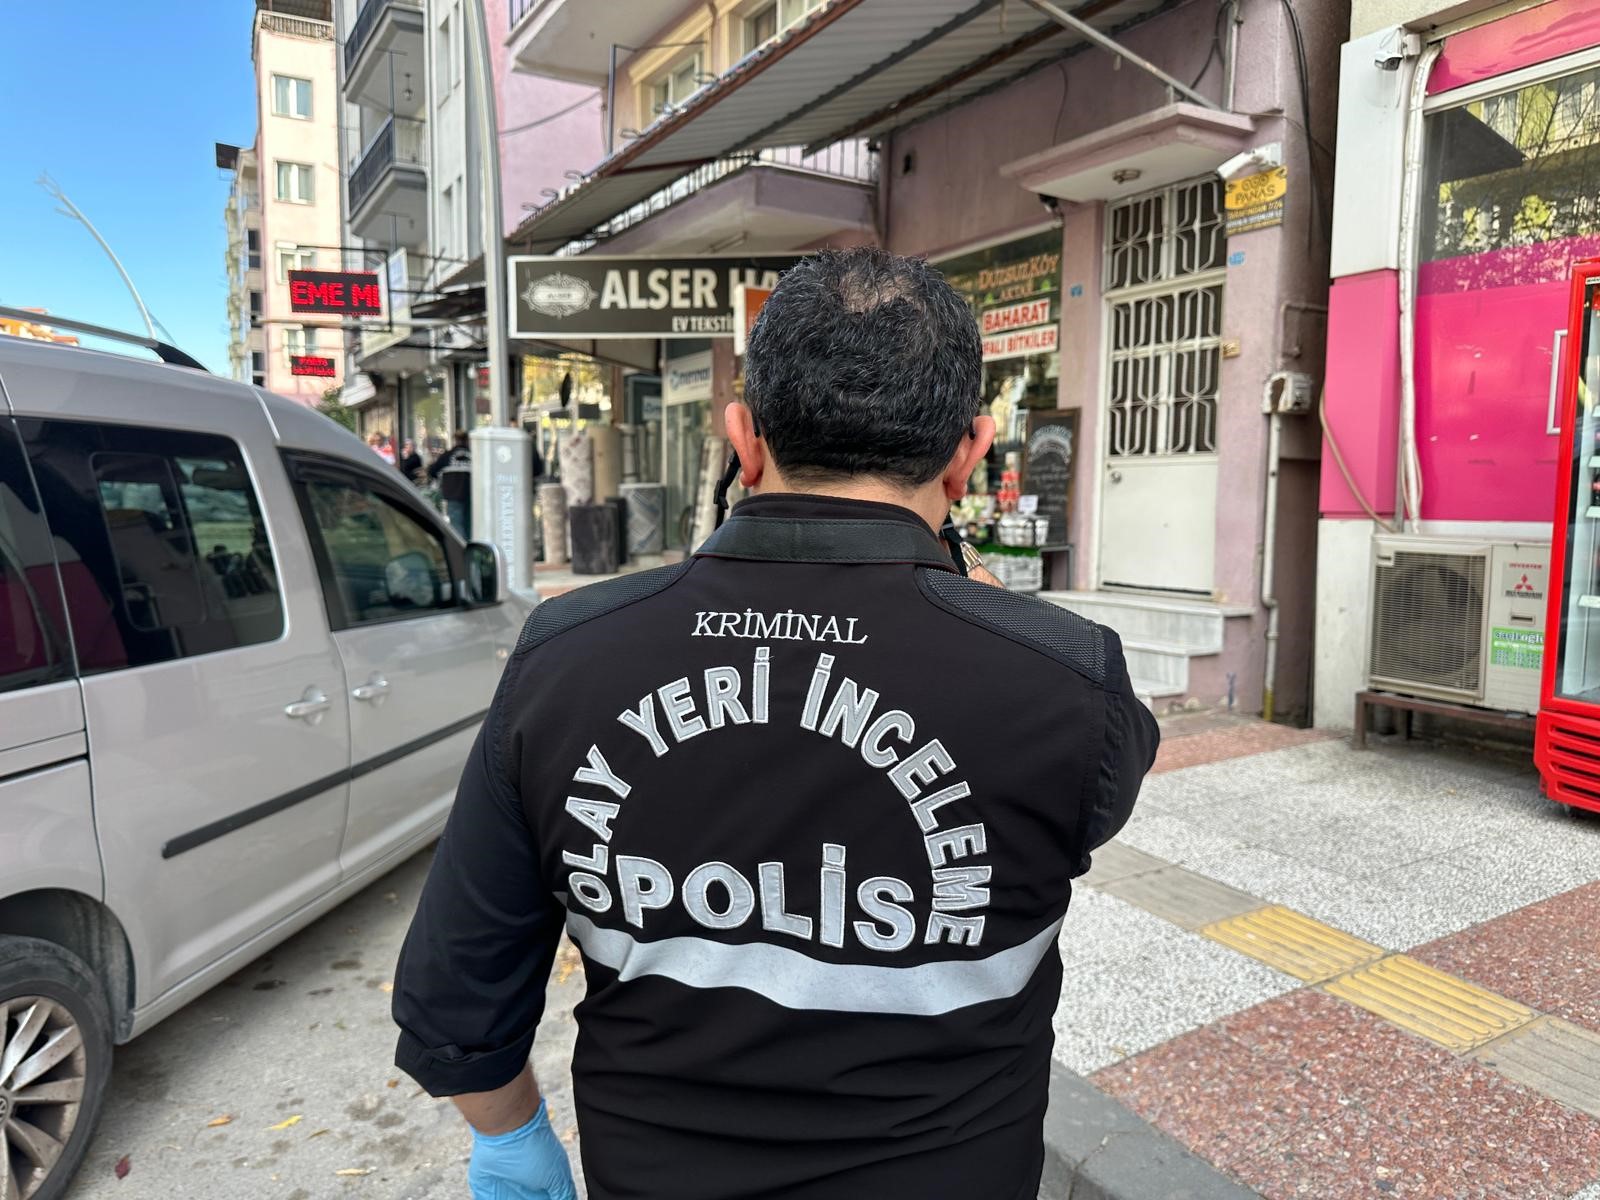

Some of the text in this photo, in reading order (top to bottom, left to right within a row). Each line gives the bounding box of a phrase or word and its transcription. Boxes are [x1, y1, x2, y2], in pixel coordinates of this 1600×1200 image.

[599, 267, 719, 310] ALSER
[672, 313, 734, 332] EV TEKSTİ
[983, 302, 1050, 331] BAHARAT
[1007, 329, 1056, 353] BİTKİLER
[691, 607, 868, 645] KRİMİNAL
[561, 645, 993, 948] OLAY YERİ İNCELEME
[615, 843, 917, 952] POLİS
